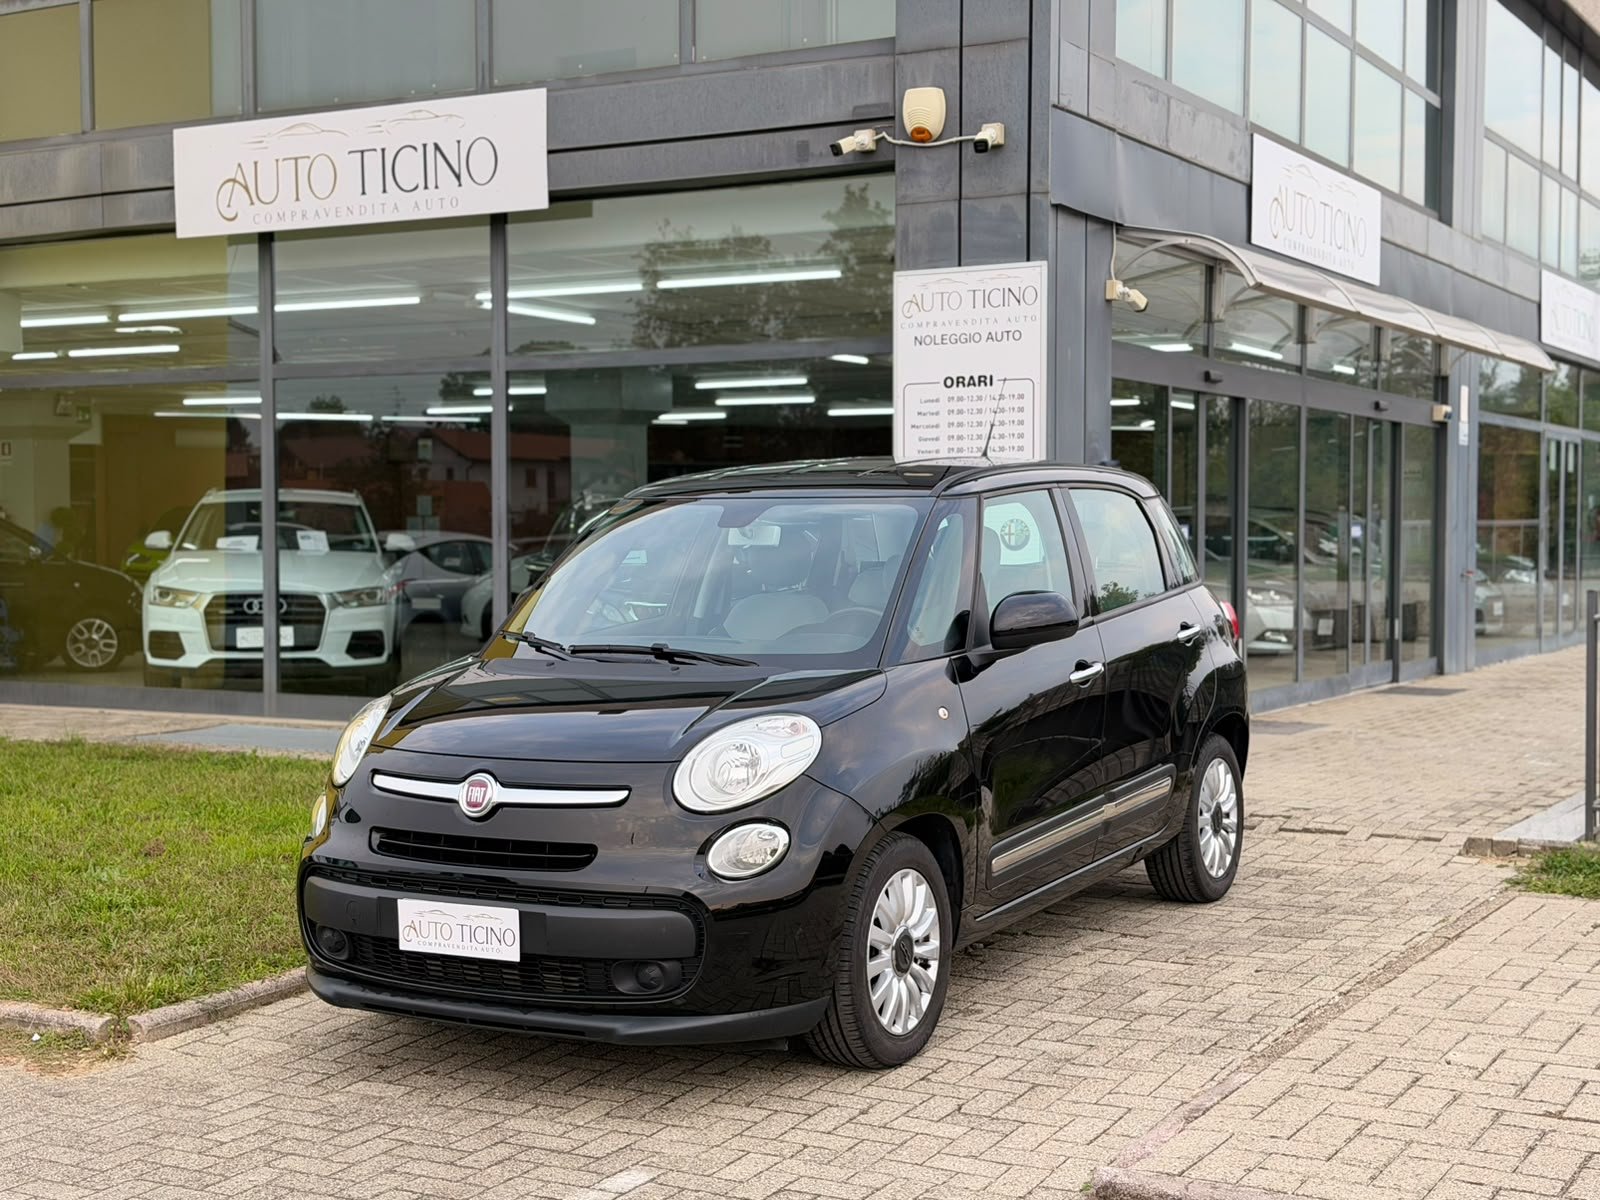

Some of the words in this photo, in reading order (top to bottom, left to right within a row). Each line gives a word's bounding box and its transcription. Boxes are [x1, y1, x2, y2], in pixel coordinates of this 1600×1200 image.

[216, 153, 338, 222] AUTO
[347, 136, 499, 196] TICINO
[252, 202, 401, 226] COMPRAVENDITA
[412, 196, 461, 212] AUTO
[1269, 184, 1317, 239] AUTO
[902, 290, 963, 319] AUTO
[967, 285, 1038, 309] TICINO
[900, 317, 999, 330] COMPRAVENDITA
[1007, 314, 1038, 323] AUTO
[914, 332, 982, 347] NOLEGGIO
[985, 330, 1023, 343] AUTO
[943, 374, 993, 389] ORARI
[467, 786, 487, 803] FIAT
[402, 920, 453, 942] AUTO
[456, 923, 516, 947] TICINO
[417, 940, 478, 952] COMPRAVENDITA
